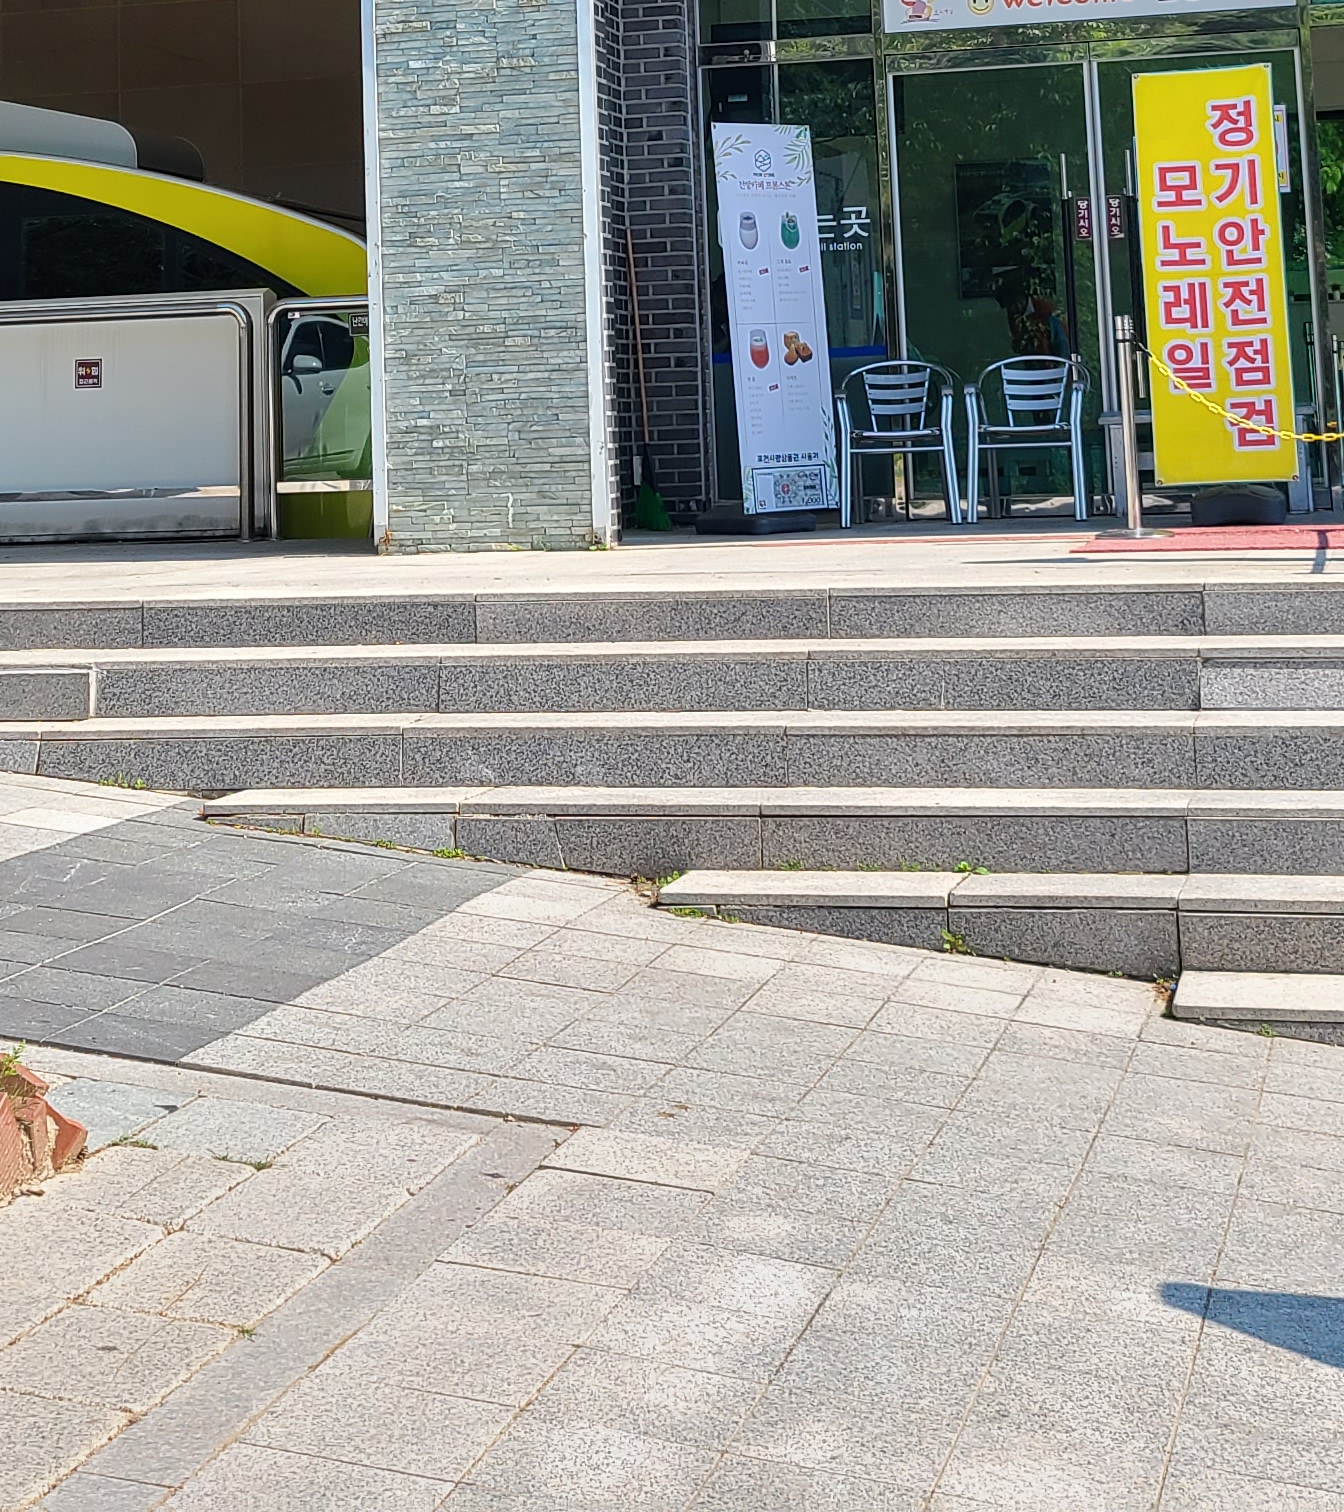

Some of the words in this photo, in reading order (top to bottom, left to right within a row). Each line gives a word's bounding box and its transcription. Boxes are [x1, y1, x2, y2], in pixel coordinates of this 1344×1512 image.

[1076, 199, 1090, 237] 당기시오
[1108, 198, 1122, 235] 당기시오
[829, 241, 863, 251] station
[1154, 163, 1213, 391] 모노레일
[1208, 97, 1278, 450] 정기안전점검
